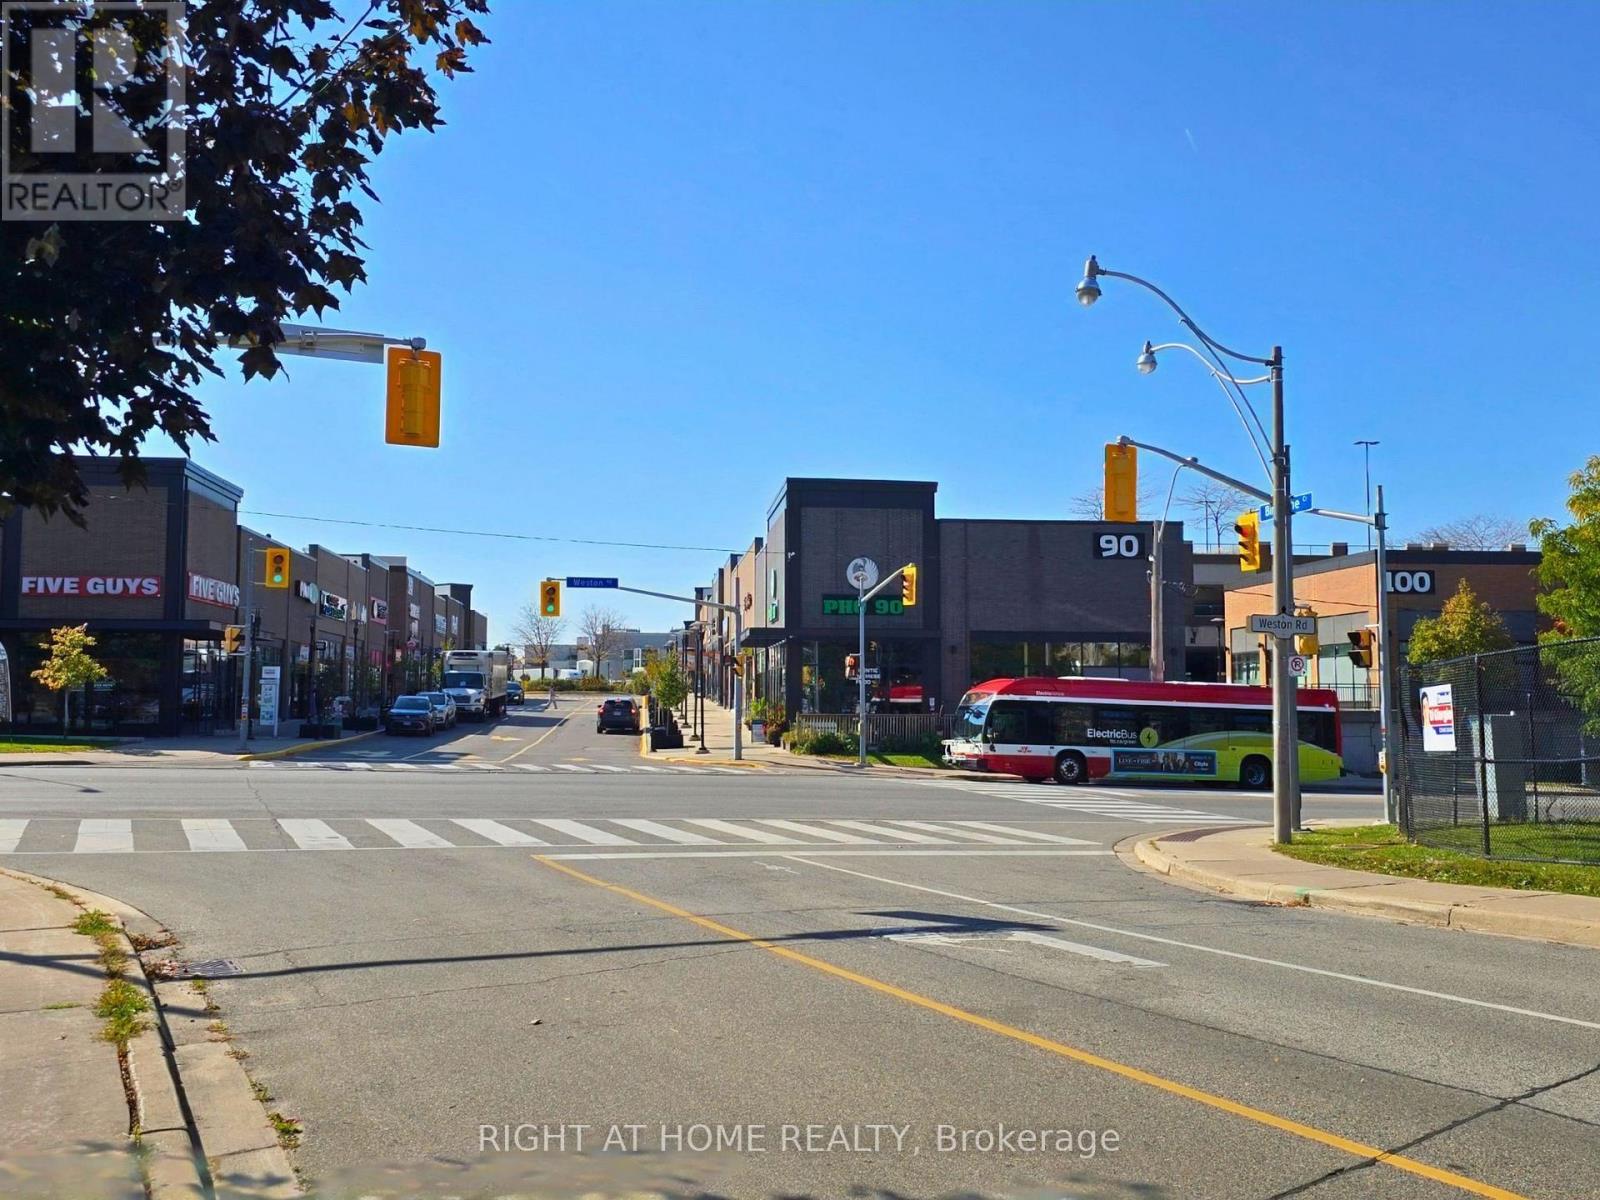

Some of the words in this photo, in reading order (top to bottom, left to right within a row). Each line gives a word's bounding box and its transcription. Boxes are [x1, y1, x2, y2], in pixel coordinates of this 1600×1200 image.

[1100, 535, 1139, 557] 90
[21, 576, 80, 594] FIVE
[86, 577, 160, 595] GUYS
[192, 574, 216, 600] FIVE
[216, 581, 240, 607] GUYS
[573, 578, 604, 586] Weston
[1385, 571, 1431, 593] 100
[875, 599, 904, 614] 90
[1259, 618, 1293, 630] Weston
[1295, 619, 1308, 630] Rd
